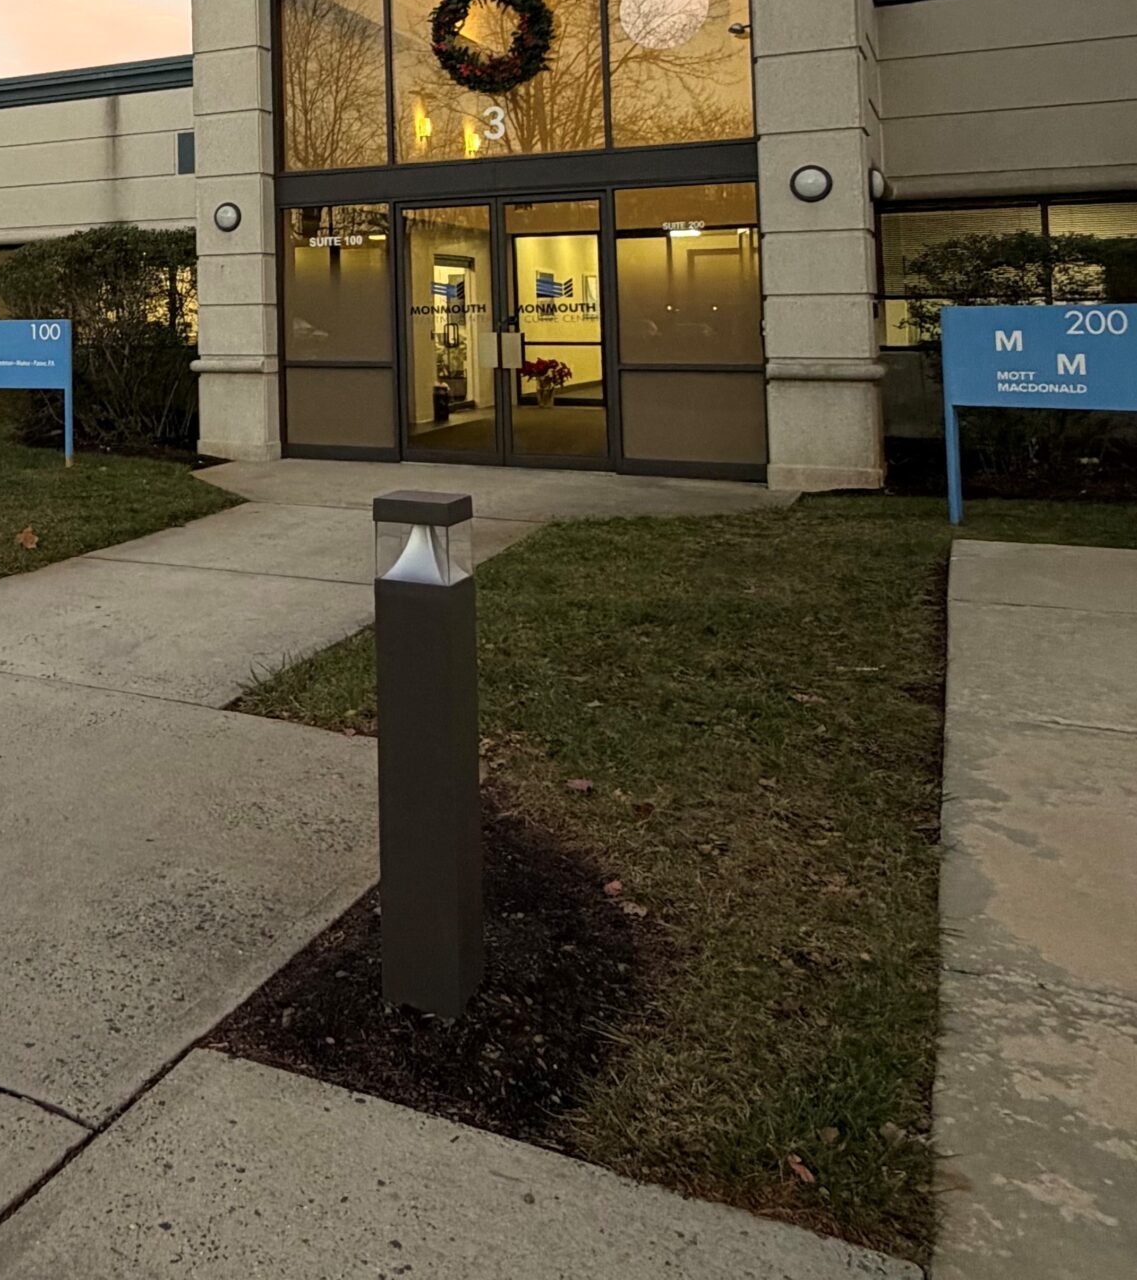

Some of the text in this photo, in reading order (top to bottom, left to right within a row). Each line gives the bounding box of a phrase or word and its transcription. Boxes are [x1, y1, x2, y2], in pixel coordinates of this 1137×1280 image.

[483, 106, 505, 140] 3
[662, 220, 705, 230] SUITE 200
[309, 235, 363, 247] SUITE 100
[410, 303, 486, 315] MONMOUTH
[515, 303, 596, 313] MONMOUTH
[1064, 310, 1128, 335] 200
[30, 323, 61, 340] 100
[995, 330, 1023, 352] M
[1057, 353, 1087, 376] M
[997, 371, 1035, 381] MOTT
[997, 382, 1087, 394] MACDONALD
